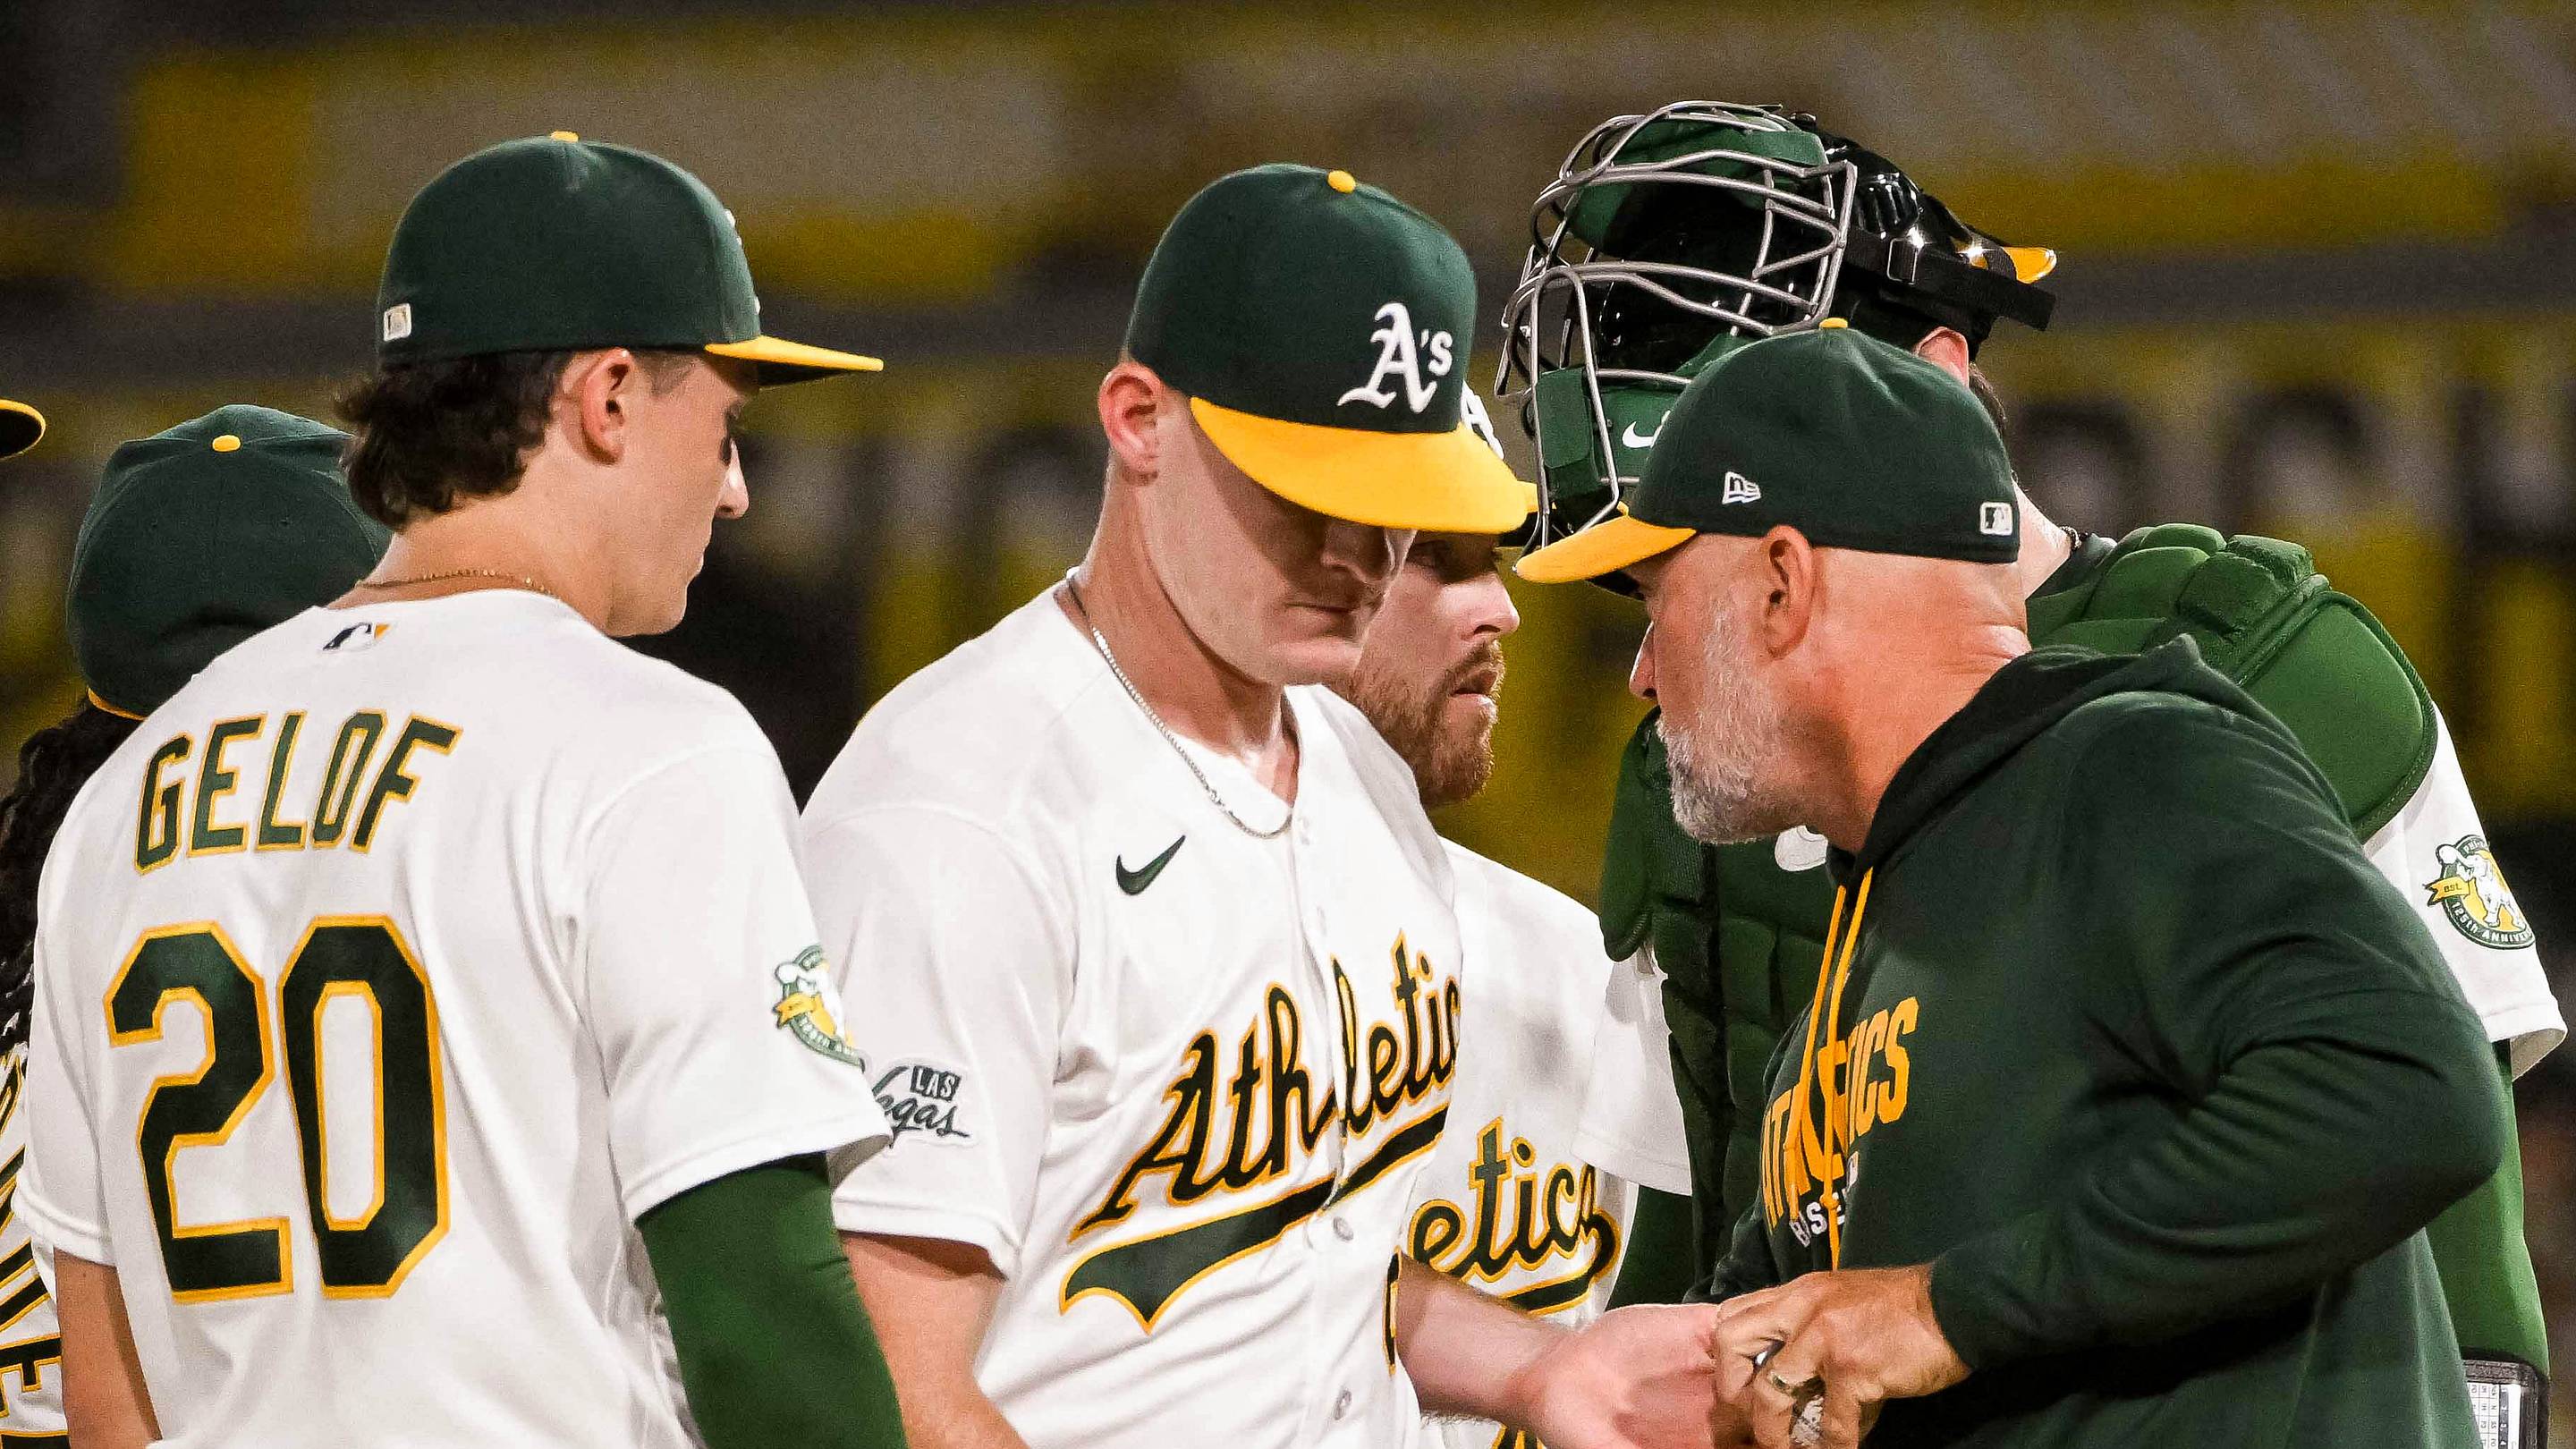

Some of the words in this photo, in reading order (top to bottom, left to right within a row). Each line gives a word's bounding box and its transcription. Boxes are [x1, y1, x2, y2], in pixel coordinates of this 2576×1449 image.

[1337, 302, 1453, 413] A's
[135, 708, 462, 875] GELOF
[103, 914, 450, 1304] 20
[912, 1066, 958, 1099] LAS
[1068, 928, 1462, 1244] Athletic
